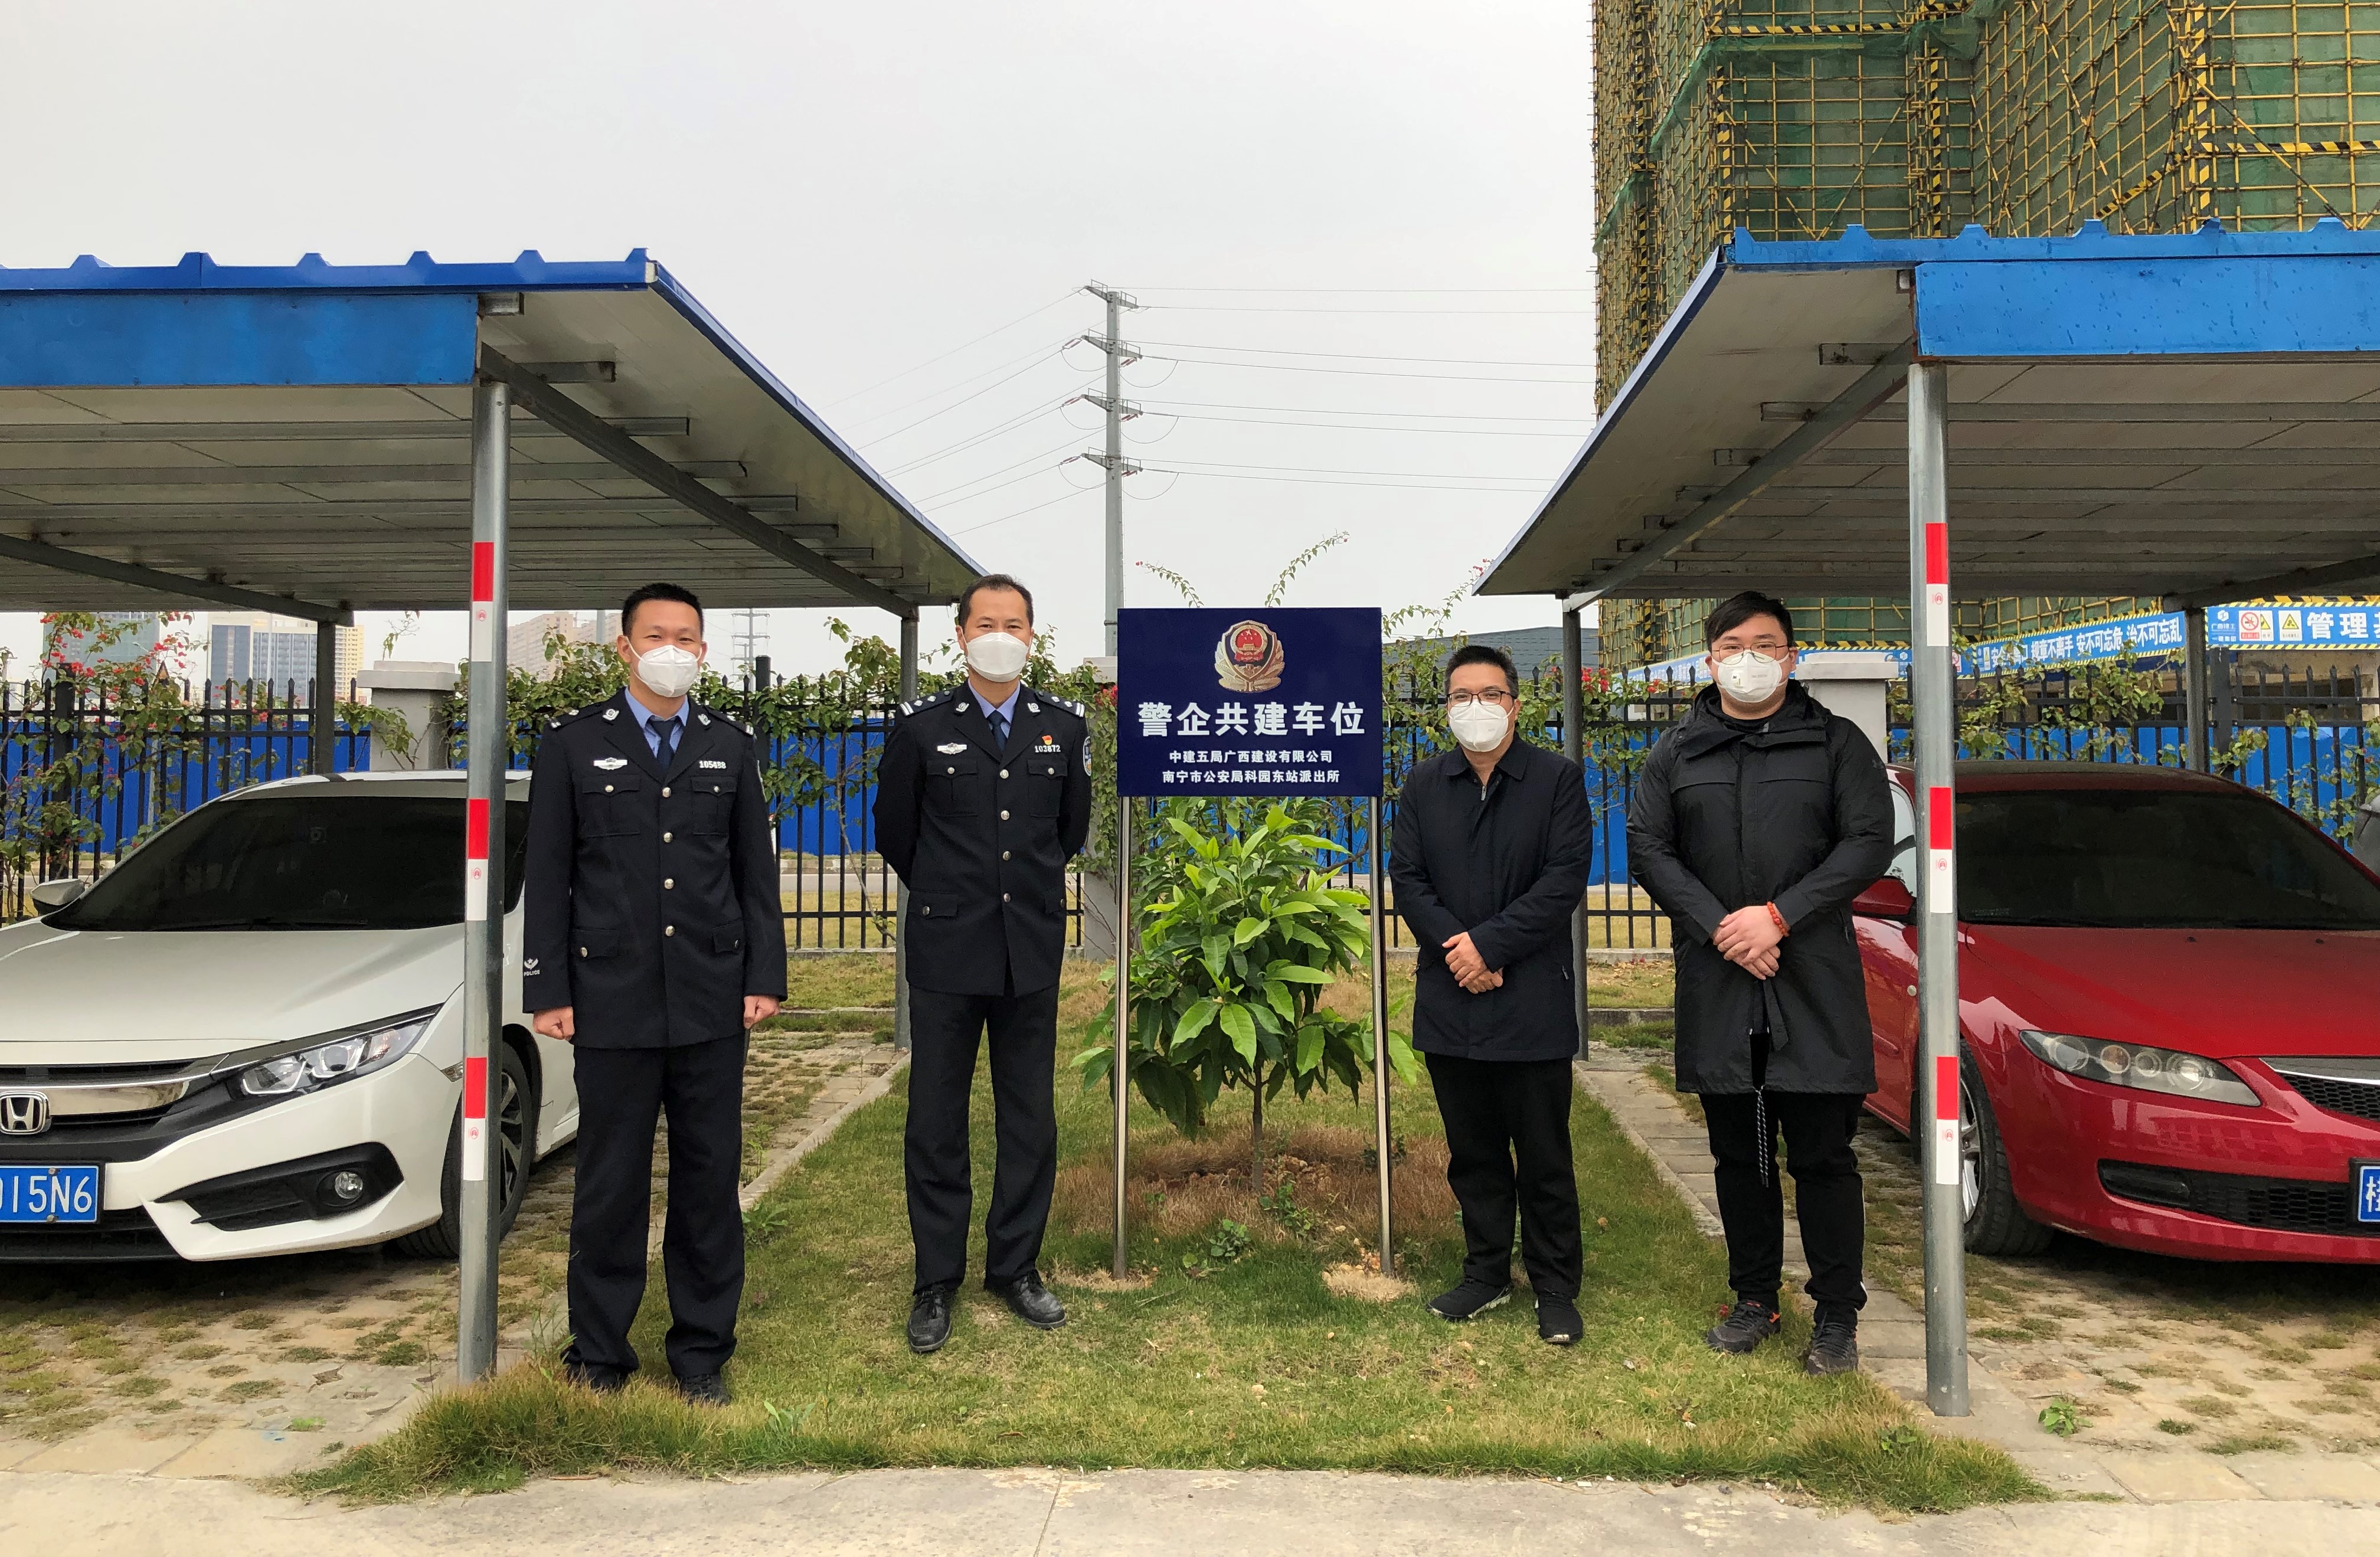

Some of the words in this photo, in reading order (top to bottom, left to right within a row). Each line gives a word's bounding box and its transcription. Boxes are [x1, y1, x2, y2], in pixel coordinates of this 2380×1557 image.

[2076, 626, 2124, 656] 安不可忘危
[2126, 617, 2182, 647] 治不可忘乱
[2307, 611, 2380, 639] 管理
[1137, 701, 1365, 737] 警企共建车位
[1034, 744, 1061, 753] 103872
[1169, 750, 1333, 764] 中建五局广西建设有限公司
[1162, 770, 1340, 783] 南宁市公安局科园东站派出所
[0, 1175, 92, 1213] 15N6
